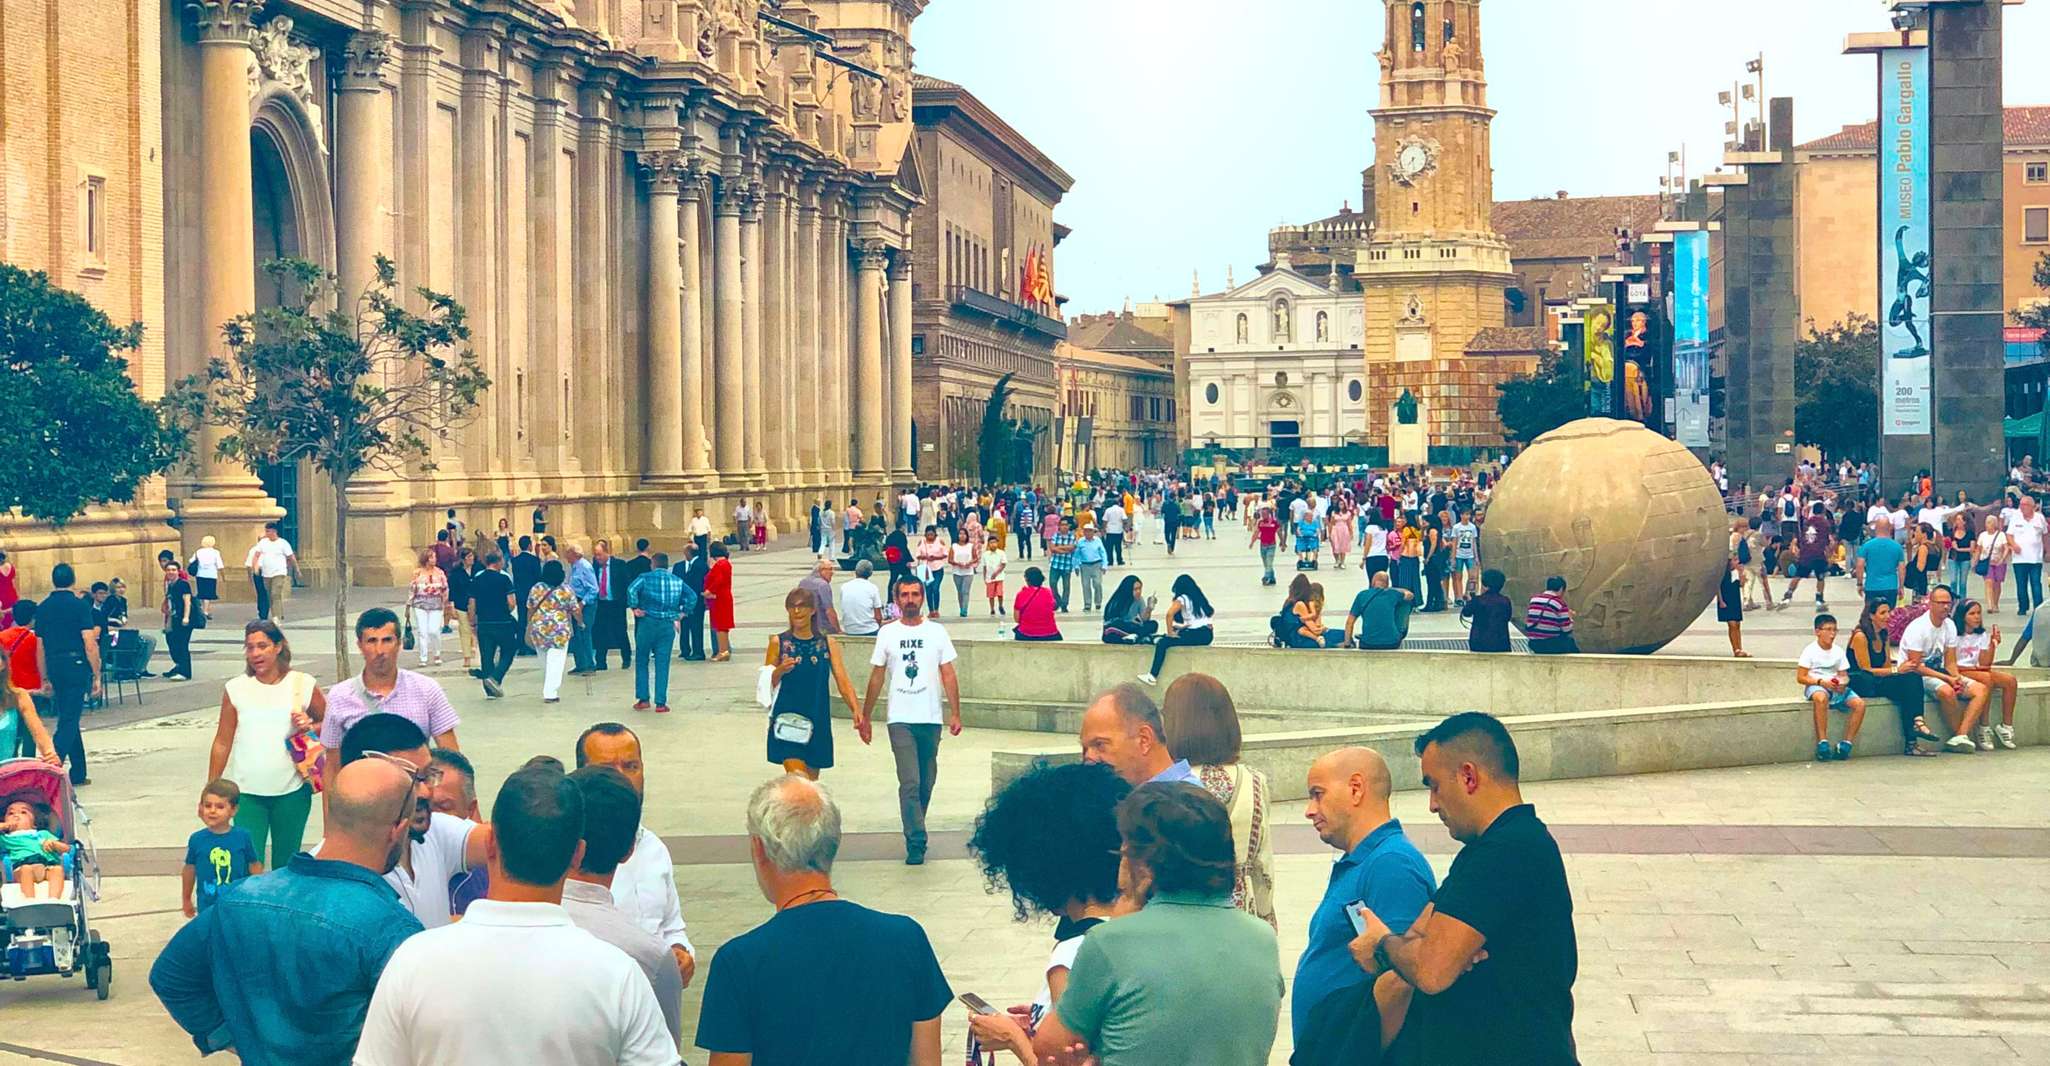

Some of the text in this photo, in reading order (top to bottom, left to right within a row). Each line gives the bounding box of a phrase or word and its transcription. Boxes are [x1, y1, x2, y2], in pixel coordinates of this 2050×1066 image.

[1897, 61, 1914, 219] MUSEO Pablo Gargallo
[1895, 387, 1913, 396] 200
[900, 639, 924, 649] RIXE
